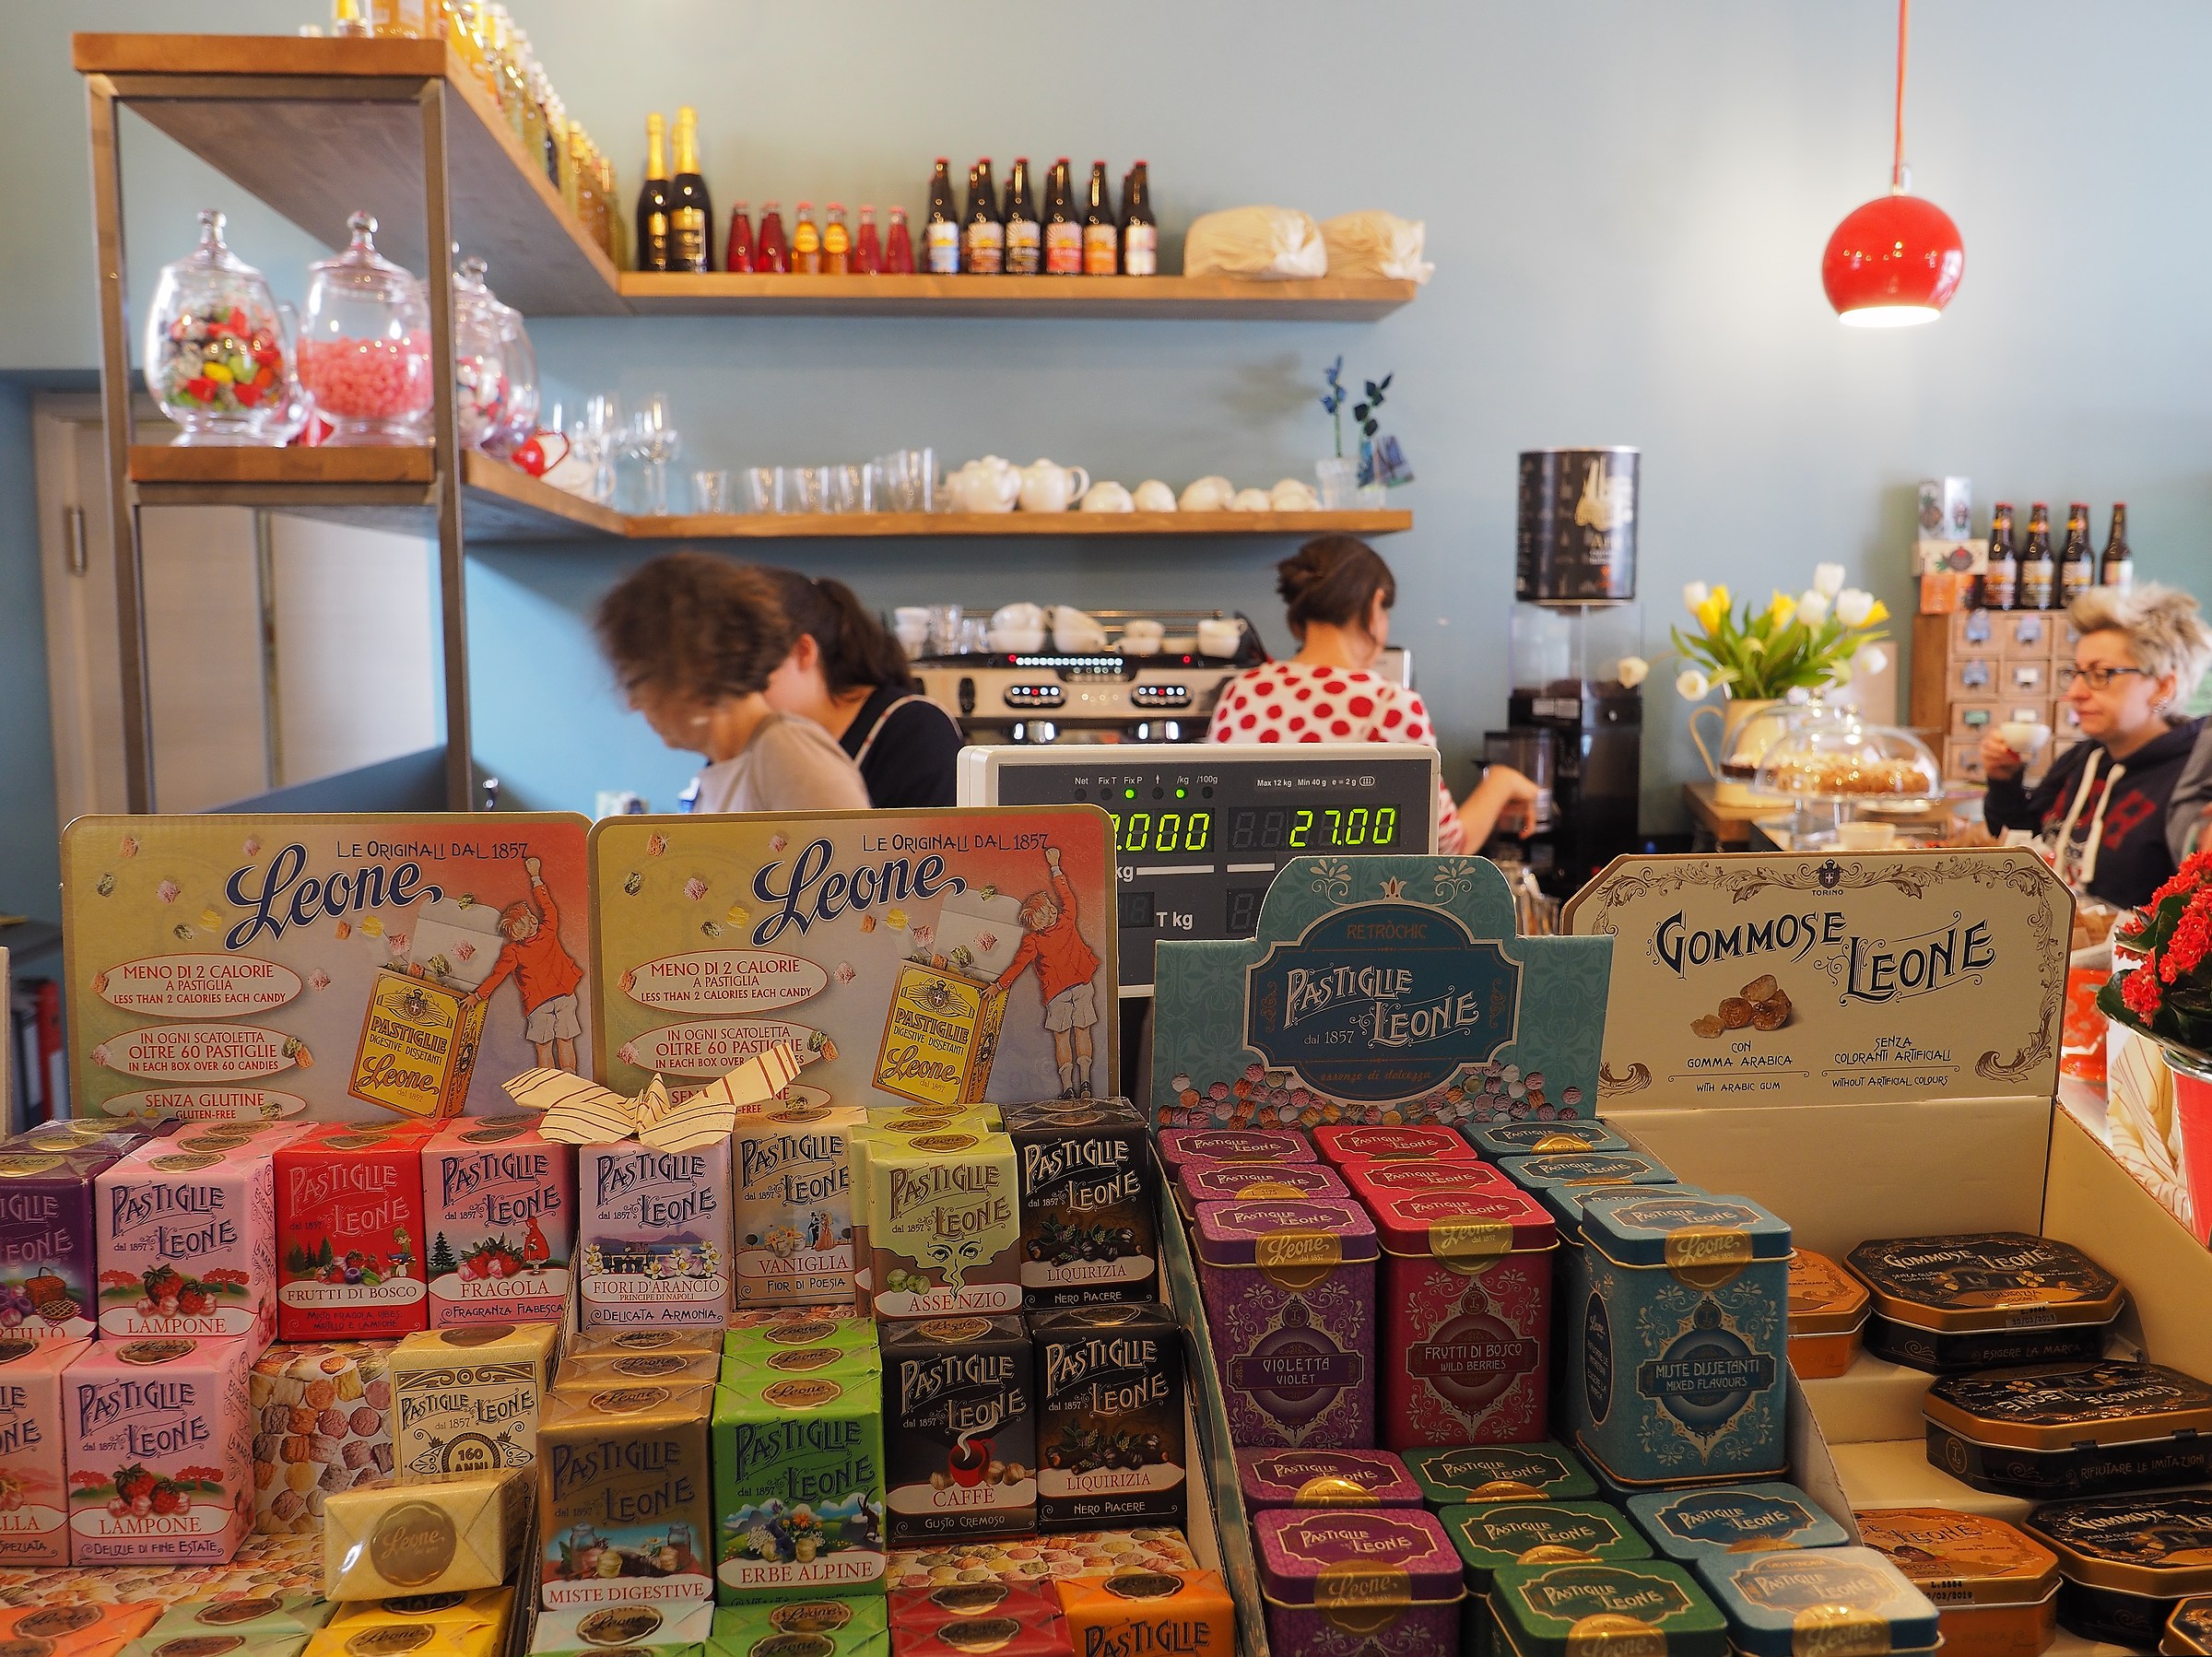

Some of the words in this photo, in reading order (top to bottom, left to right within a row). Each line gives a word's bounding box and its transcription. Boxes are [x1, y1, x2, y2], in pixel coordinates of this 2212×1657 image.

[1177, 776, 1189, 784] /kg
[1196, 775, 1218, 784] /100g
[1285, 779, 1291, 787] kg
[1289, 808, 1395, 848] 27.00
[337, 841, 362, 858] LE
[367, 841, 445, 860] ORIGINALI
[450, 843, 489, 859] DAL
[491, 843, 528, 860] 1857
[863, 835, 887, 852] LE
[892, 834, 971, 852] ORIGINALI
[974, 837, 1013, 851] DAL
[1015, 835, 1050, 851] 1857
[225, 843, 442, 951] Leone
[752, 838, 965, 946] Leone
[1157, 911, 1167, 927] T
[1171, 911, 1193, 929] kg
[1655, 910, 1847, 980] GOMMOSE
[1839, 920, 1996, 1005] LEONE
[124, 966, 172, 979] MENO
[178, 966, 191, 978] DI
[197, 966, 205, 978] 2
[210, 965, 274, 978] CALORIE
[166, 981, 174, 991] A
[179, 980, 232, 991] PASTIGLIA
[114, 995, 133, 1004] LESS
[136, 994, 162, 1003] THAN
[168, 994, 172, 1003] 2
[177, 994, 221, 1003] CALORIES
[226, 993, 249, 1003] EACH
[253, 993, 286, 1003] CANDY
[1283, 963, 1413, 1030] PASTIGLIE
[1364, 992, 1480, 1048] LEONE
[141, 1033, 153, 1043] IN
[158, 1033, 189, 1043] OGNI
[194, 1032, 265, 1043] SCATOLETTA
[371, 1016, 448, 1054] PASTIGLIE
[1304, 1033, 1320, 1045] dal
[1324, 1029, 1354, 1044] 1857
[1875, 1036, 1912, 1052] SENZA
[129, 1046, 174, 1059] OLTRE
[182, 1046, 200, 1058] 60
[206, 1045, 276, 1058] PASTIGLIE
[370, 1034, 402, 1052] DIGESTIVE
[406, 1046, 441, 1065] DISSETANTI
[1732, 1040, 1751, 1052] CON
[129, 1063, 138, 1071] IN
[143, 1063, 167, 1071] EACH
[171, 1062, 190, 1071] BOX
[195, 1062, 218, 1071] OVER
[223, 1062, 234, 1070] 60
[239, 1061, 278, 1070] CANDIES
[1688, 1058, 1733, 1068] GOMMA
[1741, 1055, 1793, 1068] ARABICA
[1834, 1050, 1888, 1065] COLORANTI
[1895, 1050, 1951, 1062] ARTIFICIALI
[358, 1054, 439, 1095] Leone
[1832, 1077, 1864, 1087] WITHOUT
[1867, 1076, 1912, 1087] ARTIFICIAL
[1914, 1075, 1947, 1087] COLOURS
[1697, 1084, 1714, 1093] WITH
[1722, 1083, 1754, 1092] ARABIC
[1760, 1082, 1781, 1090] GUM
[146, 1094, 194, 1107] SENZA
[199, 1093, 264, 1106] GLUTINE
[176, 1111, 236, 1119] GLUTEN-FREE
[1023, 1139, 1129, 1197] PASTIGLIE
[441, 1152, 549, 1209] PASTIGLIE
[596, 1153, 706, 1208] PASTIGLIE
[888, 1163, 1000, 1222] PASTIGLIE
[1066, 1171, 1140, 1212] LEONE
[112, 1181, 226, 1239] PASTIGLIE
[481, 1184, 561, 1227] LEONE
[638, 1186, 717, 1228] LEONE
[933, 1196, 1011, 1240] LEONE
[155, 1219, 238, 1260] LEONE
[1267, 1237, 1330, 1266] Leone
[1884, 1250, 1975, 1269] GOMMOSE
[1979, 1248, 2054, 1270] LEONE
[759, 1256, 848, 1274] VANIGLIA
[1047, 1265, 1126, 1283] LIQUIRIZIA
[461, 1280, 549, 1298] FRAGOLA
[594, 1281, 635, 1294] FIORI
[767, 1280, 790, 1292] FIOR
[796, 1280, 805, 1290] DI
[810, 1277, 845, 1289] POESIA
[287, 1290, 341, 1301] FRUTTI
[347, 1289, 363, 1300] DI
[370, 1287, 417, 1299] BOSCO
[1055, 1295, 1078, 1303] NERO
[1084, 1292, 1122, 1302] PIACERE
[453, 1304, 512, 1318] FRAGRANZA
[517, 1303, 564, 1316] FIABESCA
[604, 1310, 653, 1322] DELICATA
[662, 1309, 716, 1320] ARMONIA
[127, 1318, 227, 1334] LAMPONE
[1426, 1346, 1467, 1360] FRUTTI
[1470, 1346, 1483, 1358] DI
[1486, 1344, 1522, 1357] BOSCO
[1983, 1348, 2021, 1359] ESIGERE
[2028, 1348, 2038, 1357] LA
[2043, 1345, 2081, 1356] MARCA
[1263, 1358, 1329, 1371] VIOLETTA
[1441, 1362, 1464, 1372] WILD
[1466, 1360, 1506, 1370] BERRIES
[1656, 1363, 1688, 1378] MISTE
[1694, 1359, 1759, 1376] DISSETANTI
[900, 1354, 1015, 1417] PASTIGLIE
[1277, 1375, 1314, 1384] VIOLET
[1666, 1379, 1694, 1392] MIXED
[1697, 1376, 1747, 1390] FLAVOURS
[945, 1387, 1026, 1434] LEONE
[734, 1418, 863, 1485] PASTIGLIE
[783, 1455, 876, 1504] LEONE
[2081, 1463, 2132, 1478] RIFIUTARE
[2137, 1463, 2147, 1472] LE
[933, 1486, 994, 1508] CAFFÈ
[100, 1518, 202, 1534] LAMPONE
[925, 1519, 955, 1531] GUSTO
[959, 1516, 1005, 1526] CREMOSO
[94, 1543, 134, 1556] DELIZIE
[139, 1545, 147, 1553] DI
[152, 1543, 174, 1553] FINE
[180, 1541, 217, 1555] ESTATE
[741, 1567, 793, 1583] ERBE
[797, 1562, 873, 1581] ALPINE
[549, 1587, 606, 1604] MISTE
[608, 1582, 704, 1601] DIGESTIVE
